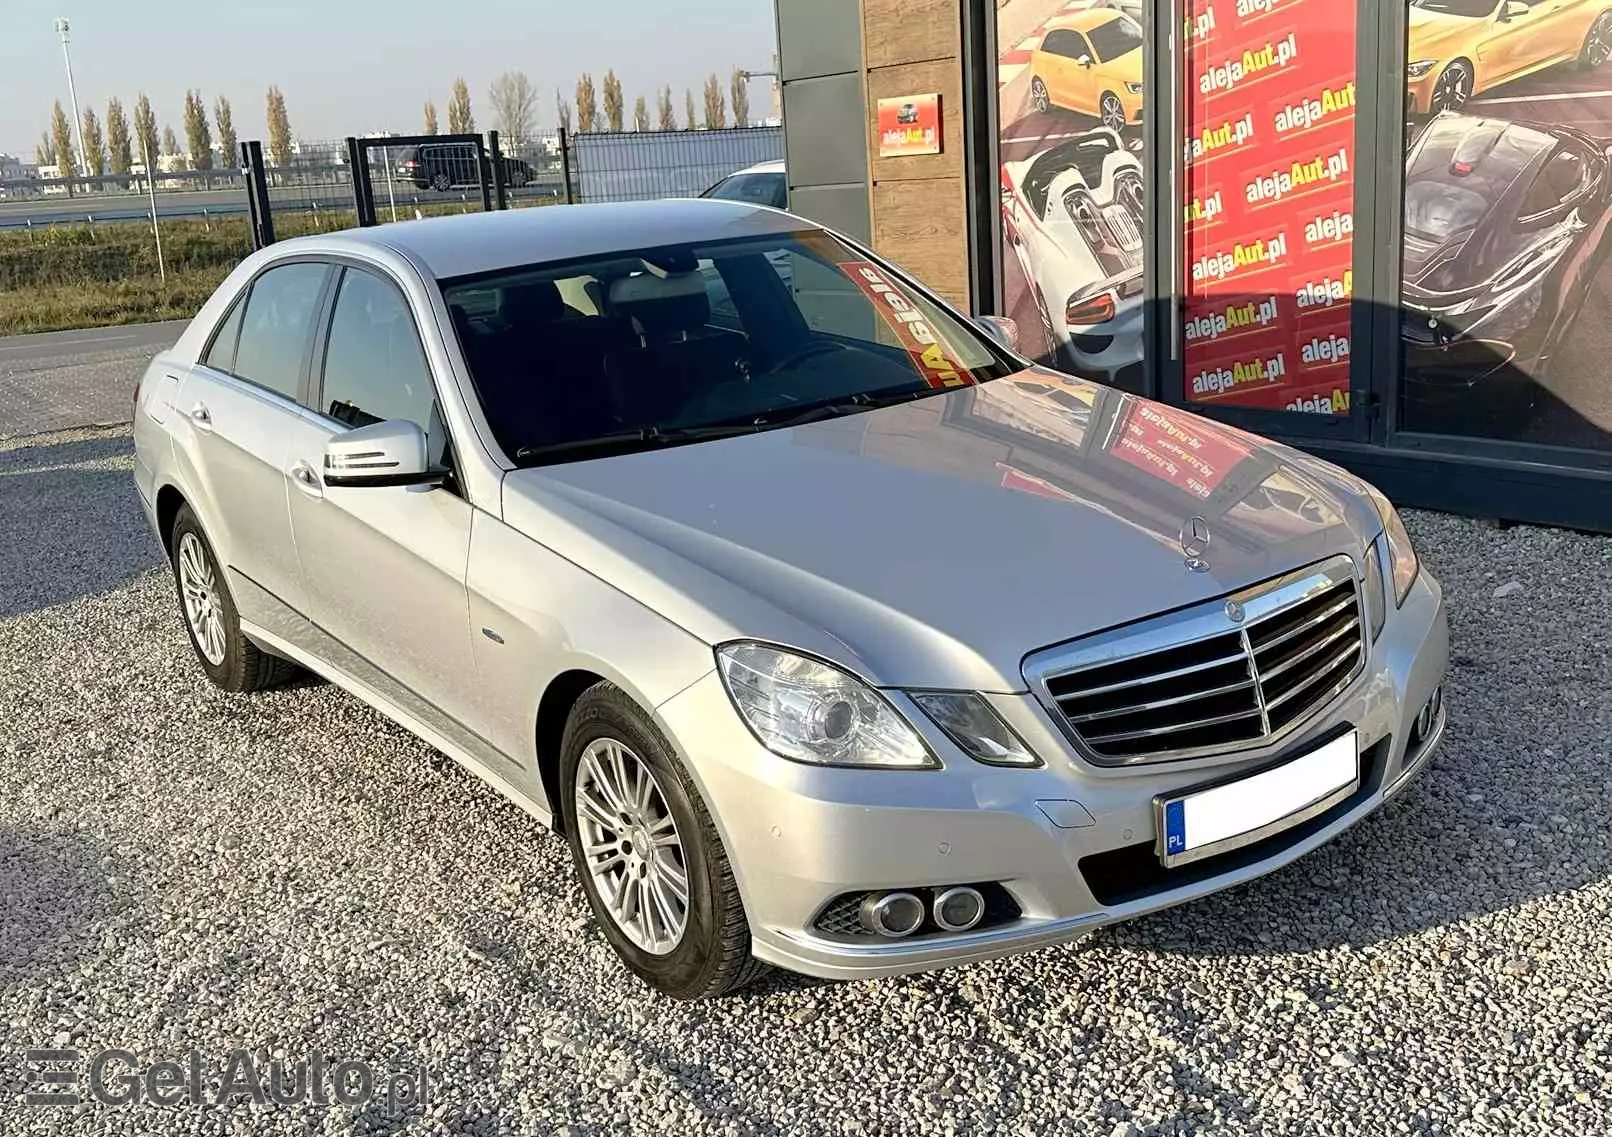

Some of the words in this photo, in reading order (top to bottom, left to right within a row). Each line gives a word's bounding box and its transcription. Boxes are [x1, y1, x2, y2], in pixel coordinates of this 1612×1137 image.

[1200, 33, 1297, 93] alejaAut.pl
[1275, 82, 1356, 131] alejaAut
[1246, 149, 1348, 202] alejaAut.pl
[1305, 211, 1353, 243] aleja
[1192, 233, 1287, 280] alejaAut.pl
[1185, 297, 1278, 340] alejaAut.pl
[1302, 335, 1349, 363] aleja
[1192, 354, 1286, 393] alejaAut.pl
[1169, 834, 1183, 848] PL
